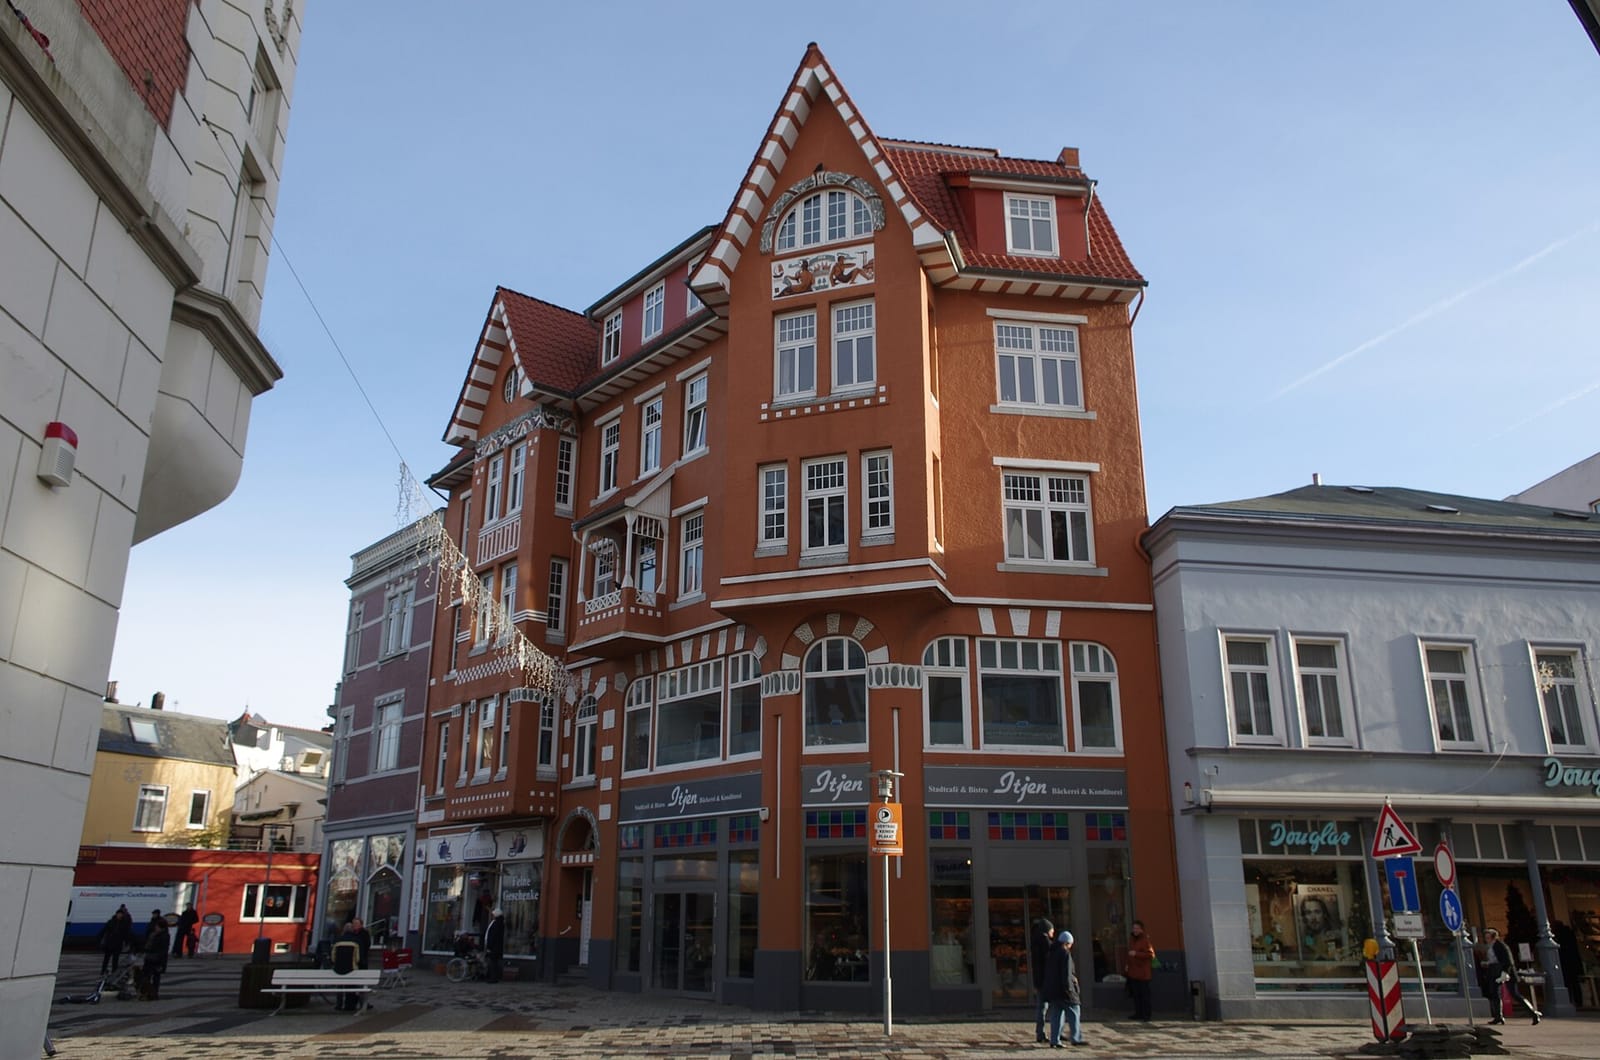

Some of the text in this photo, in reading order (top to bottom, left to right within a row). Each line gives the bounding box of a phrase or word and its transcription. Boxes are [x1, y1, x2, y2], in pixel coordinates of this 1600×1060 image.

[668, 786, 697, 814] Itjen
[809, 769, 864, 802] Itjen
[960, 785, 967, 793] &
[968, 785, 989, 793] Bistro
[993, 770, 1048, 803] Itjen
[1080, 787, 1087, 795] &
[1269, 821, 1351, 854] Douglas
[502, 889, 539, 901] Geschenke
